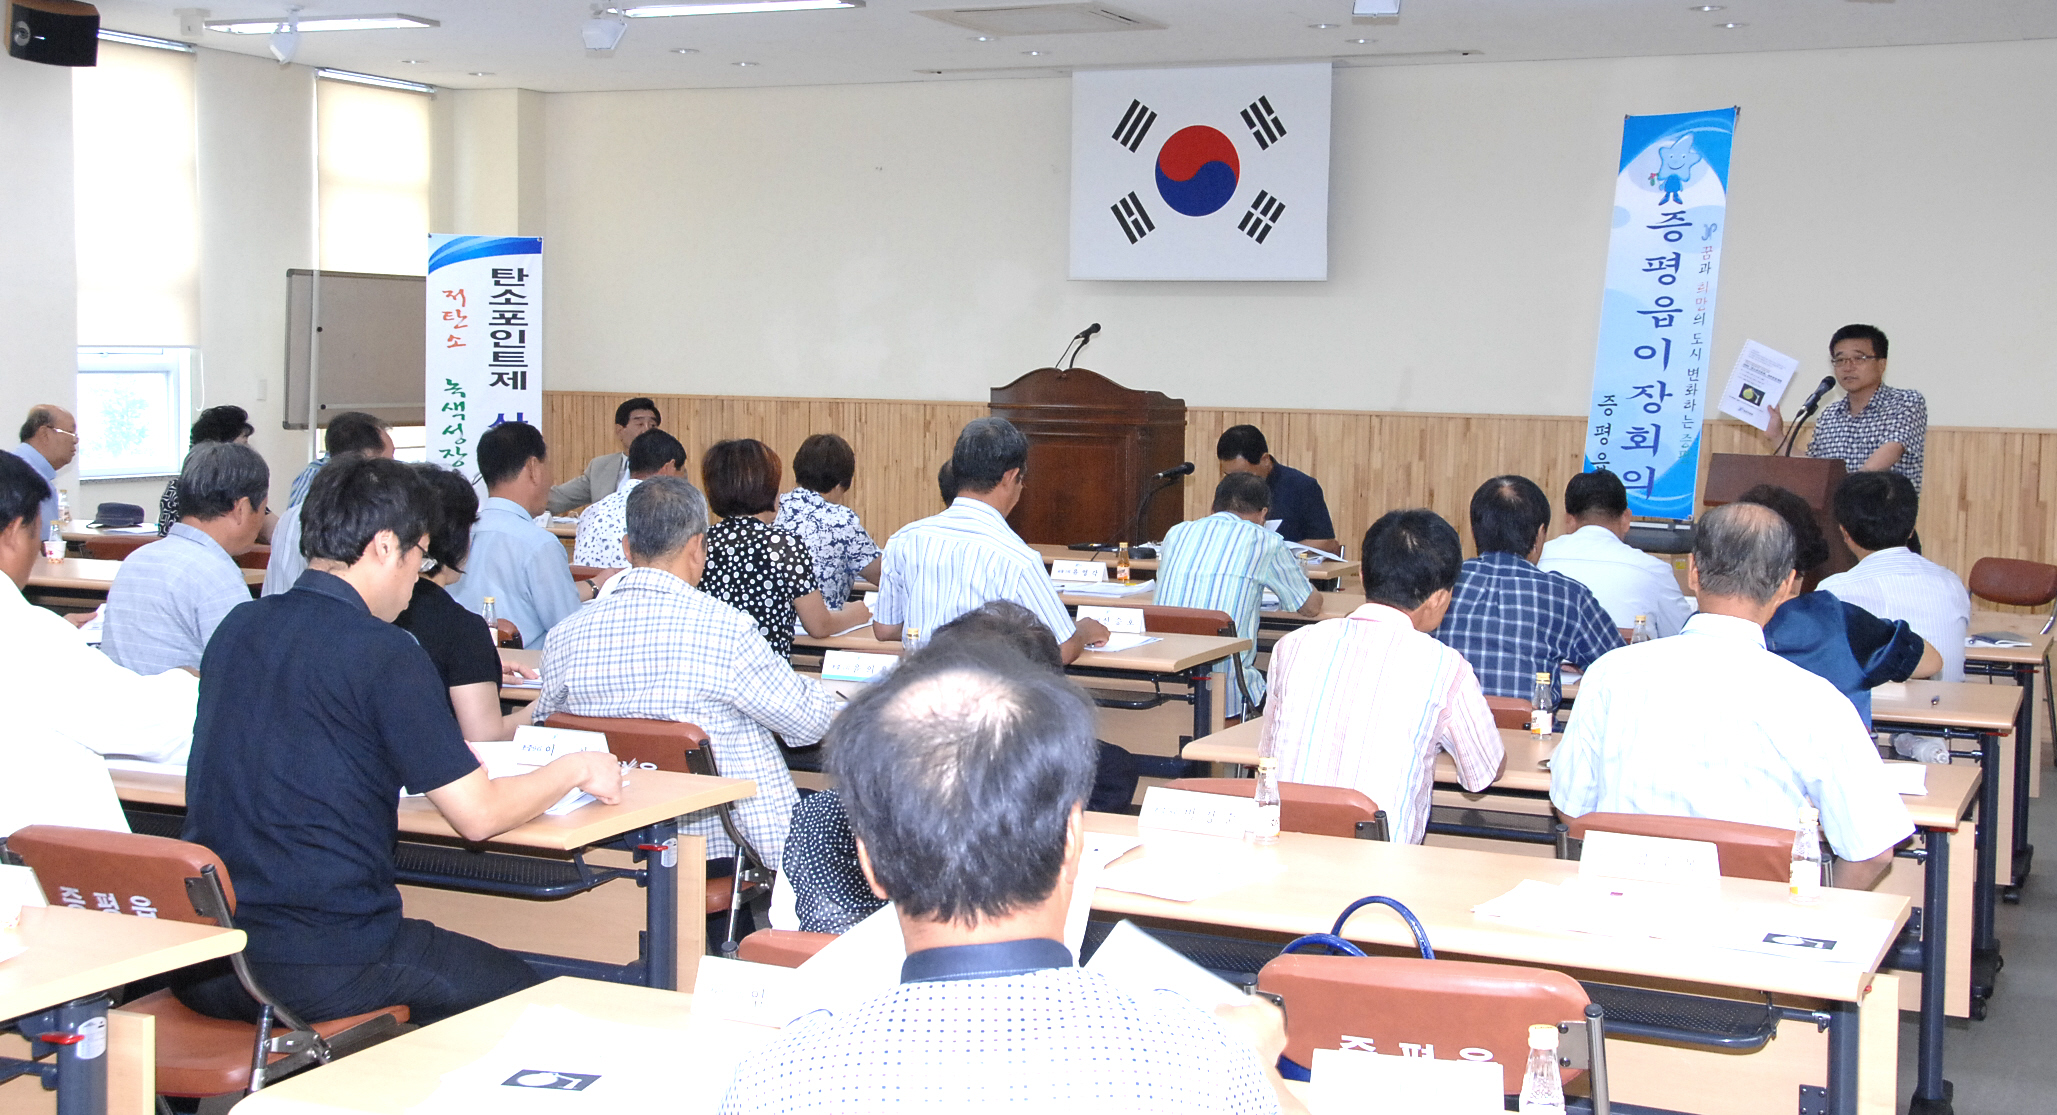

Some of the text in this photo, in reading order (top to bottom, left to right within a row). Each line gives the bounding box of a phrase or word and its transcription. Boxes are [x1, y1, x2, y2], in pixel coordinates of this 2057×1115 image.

[1698, 246, 1713, 275] 꿈과
[488, 267, 529, 390] 탄소포인트제
[1693, 281, 1709, 326] 희망의
[1689, 333, 1703, 362] 도시
[439, 288, 468, 468] 저탄소 녹색성장
[1681, 367, 1700, 429] 변화하는
